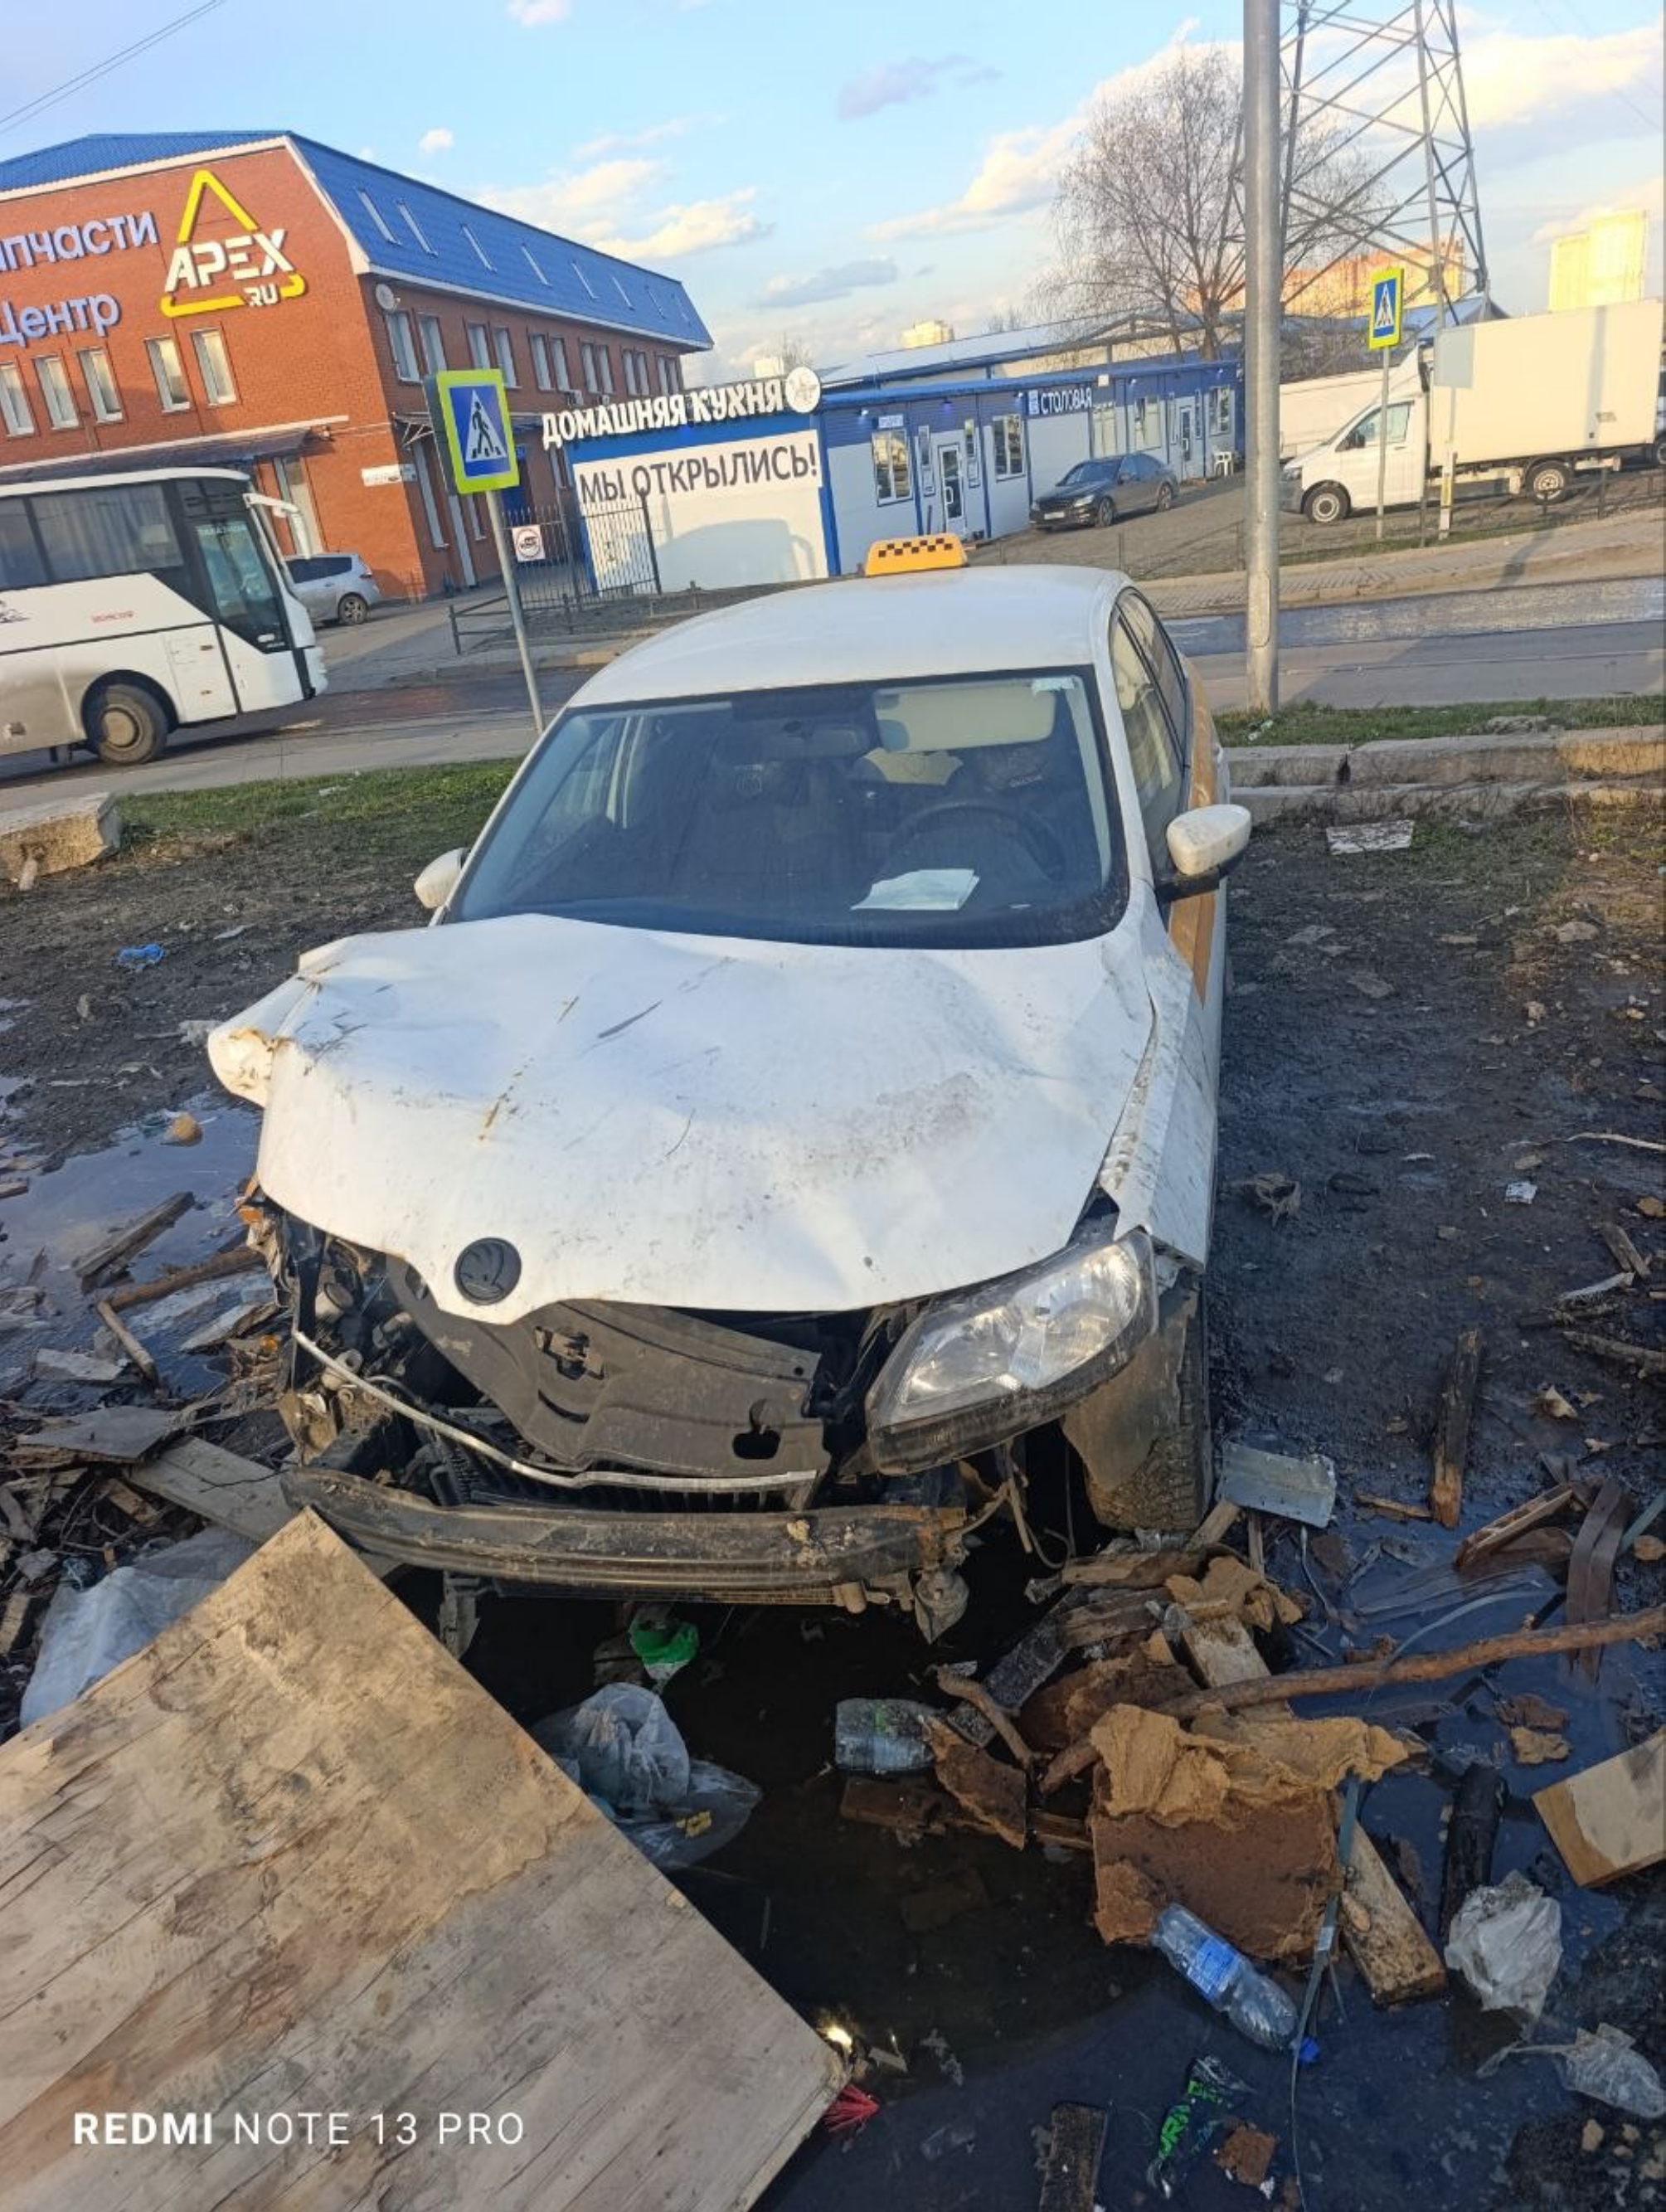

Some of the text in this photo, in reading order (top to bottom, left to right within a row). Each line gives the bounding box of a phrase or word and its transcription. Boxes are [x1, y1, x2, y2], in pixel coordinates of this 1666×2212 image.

[164, 228, 294, 293] APEX
[542, 380, 784, 450] ДОМАШНЯЯ КУХНЯ
[1041, 386, 1092, 415] СТОЛОВАЯ
[580, 443, 818, 504] МЫ ОТКРЫЛИСЬ!
